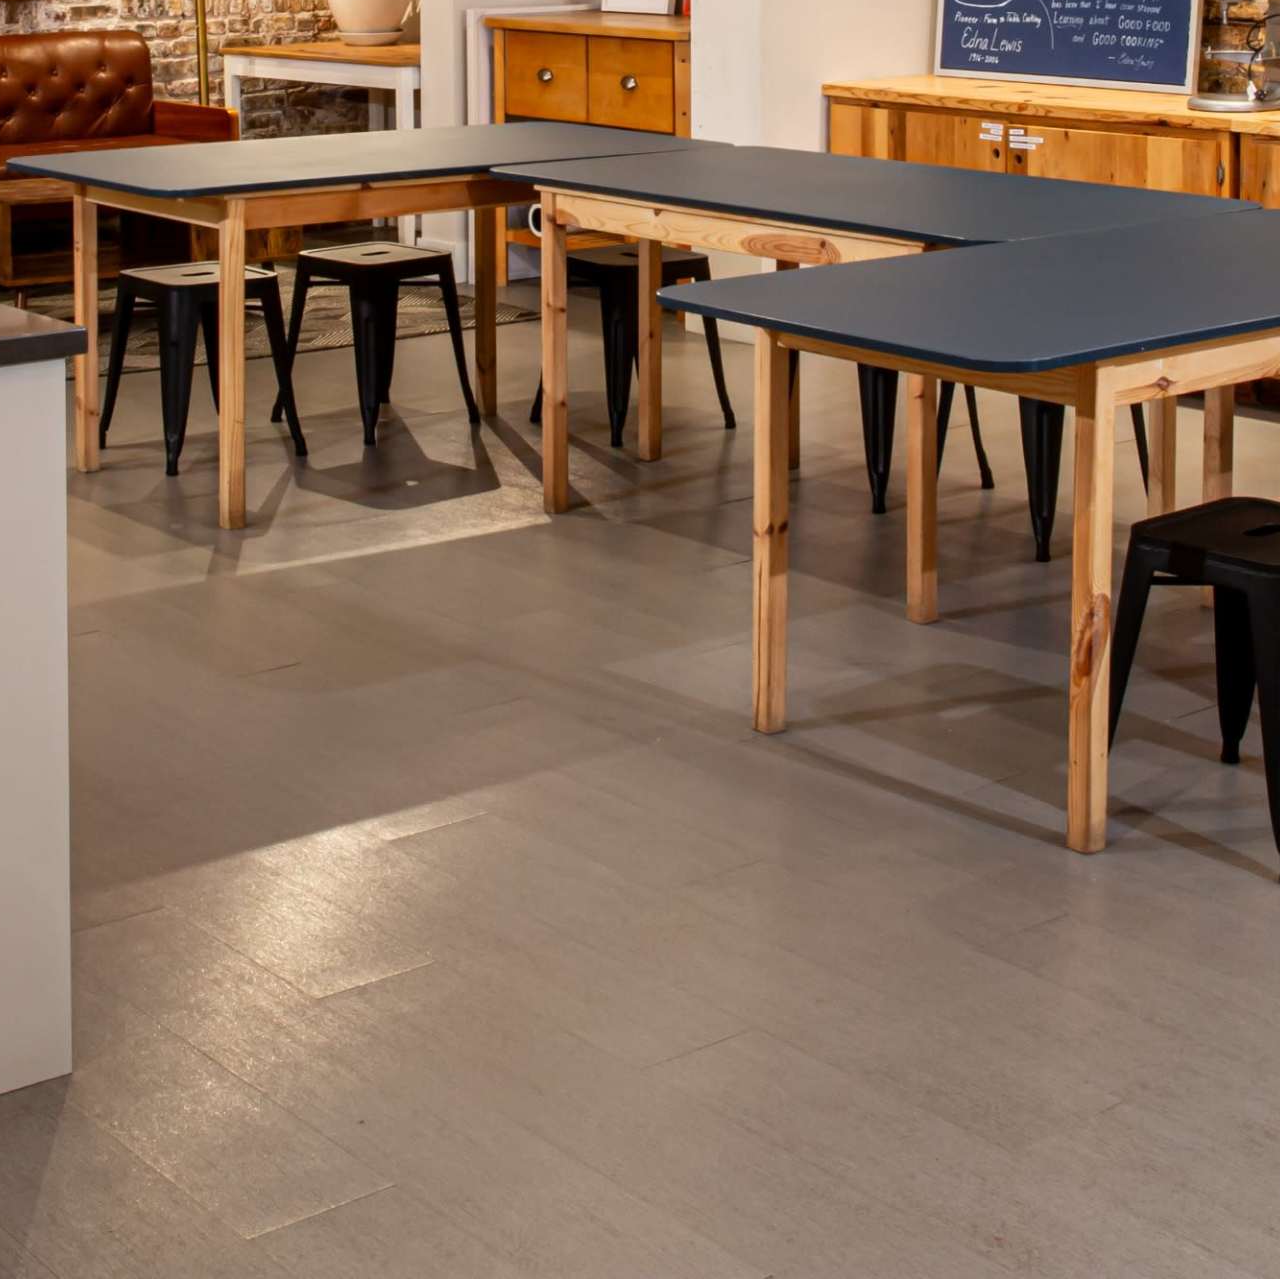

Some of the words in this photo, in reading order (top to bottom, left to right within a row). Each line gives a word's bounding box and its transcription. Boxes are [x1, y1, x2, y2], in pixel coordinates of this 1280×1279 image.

[1118, 15, 1143, 30] GOOD
[1146, 20, 1171, 32] FOOD
[960, 26, 989, 50] Edna
[990, 27, 1023, 52] Lewis
[1092, 32, 1116, 46] GOOD
